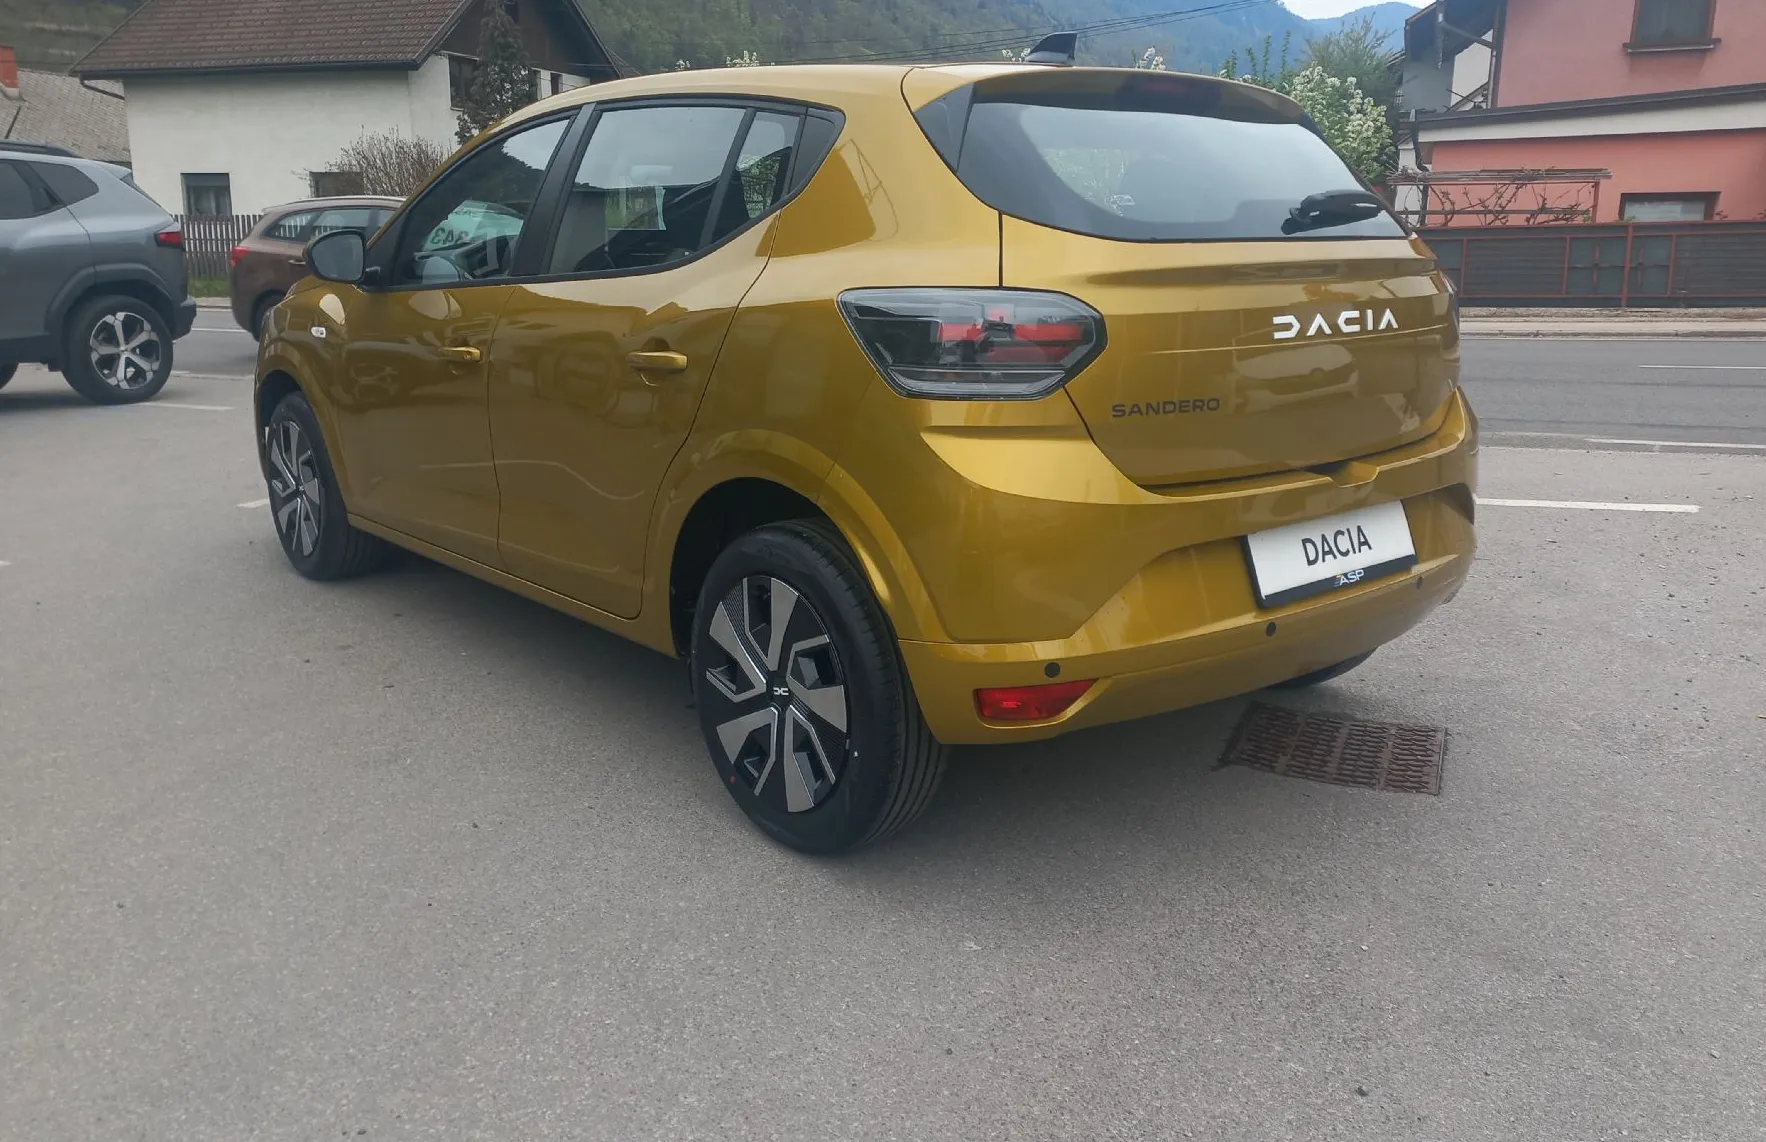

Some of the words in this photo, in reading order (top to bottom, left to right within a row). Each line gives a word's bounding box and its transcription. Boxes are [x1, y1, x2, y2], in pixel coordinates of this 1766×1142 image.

[1272, 308, 1399, 339] DACIA
[1111, 398, 1220, 418] SANDERO
[1301, 524, 1373, 567] DACIA
[1336, 569, 1365, 586] ASP
